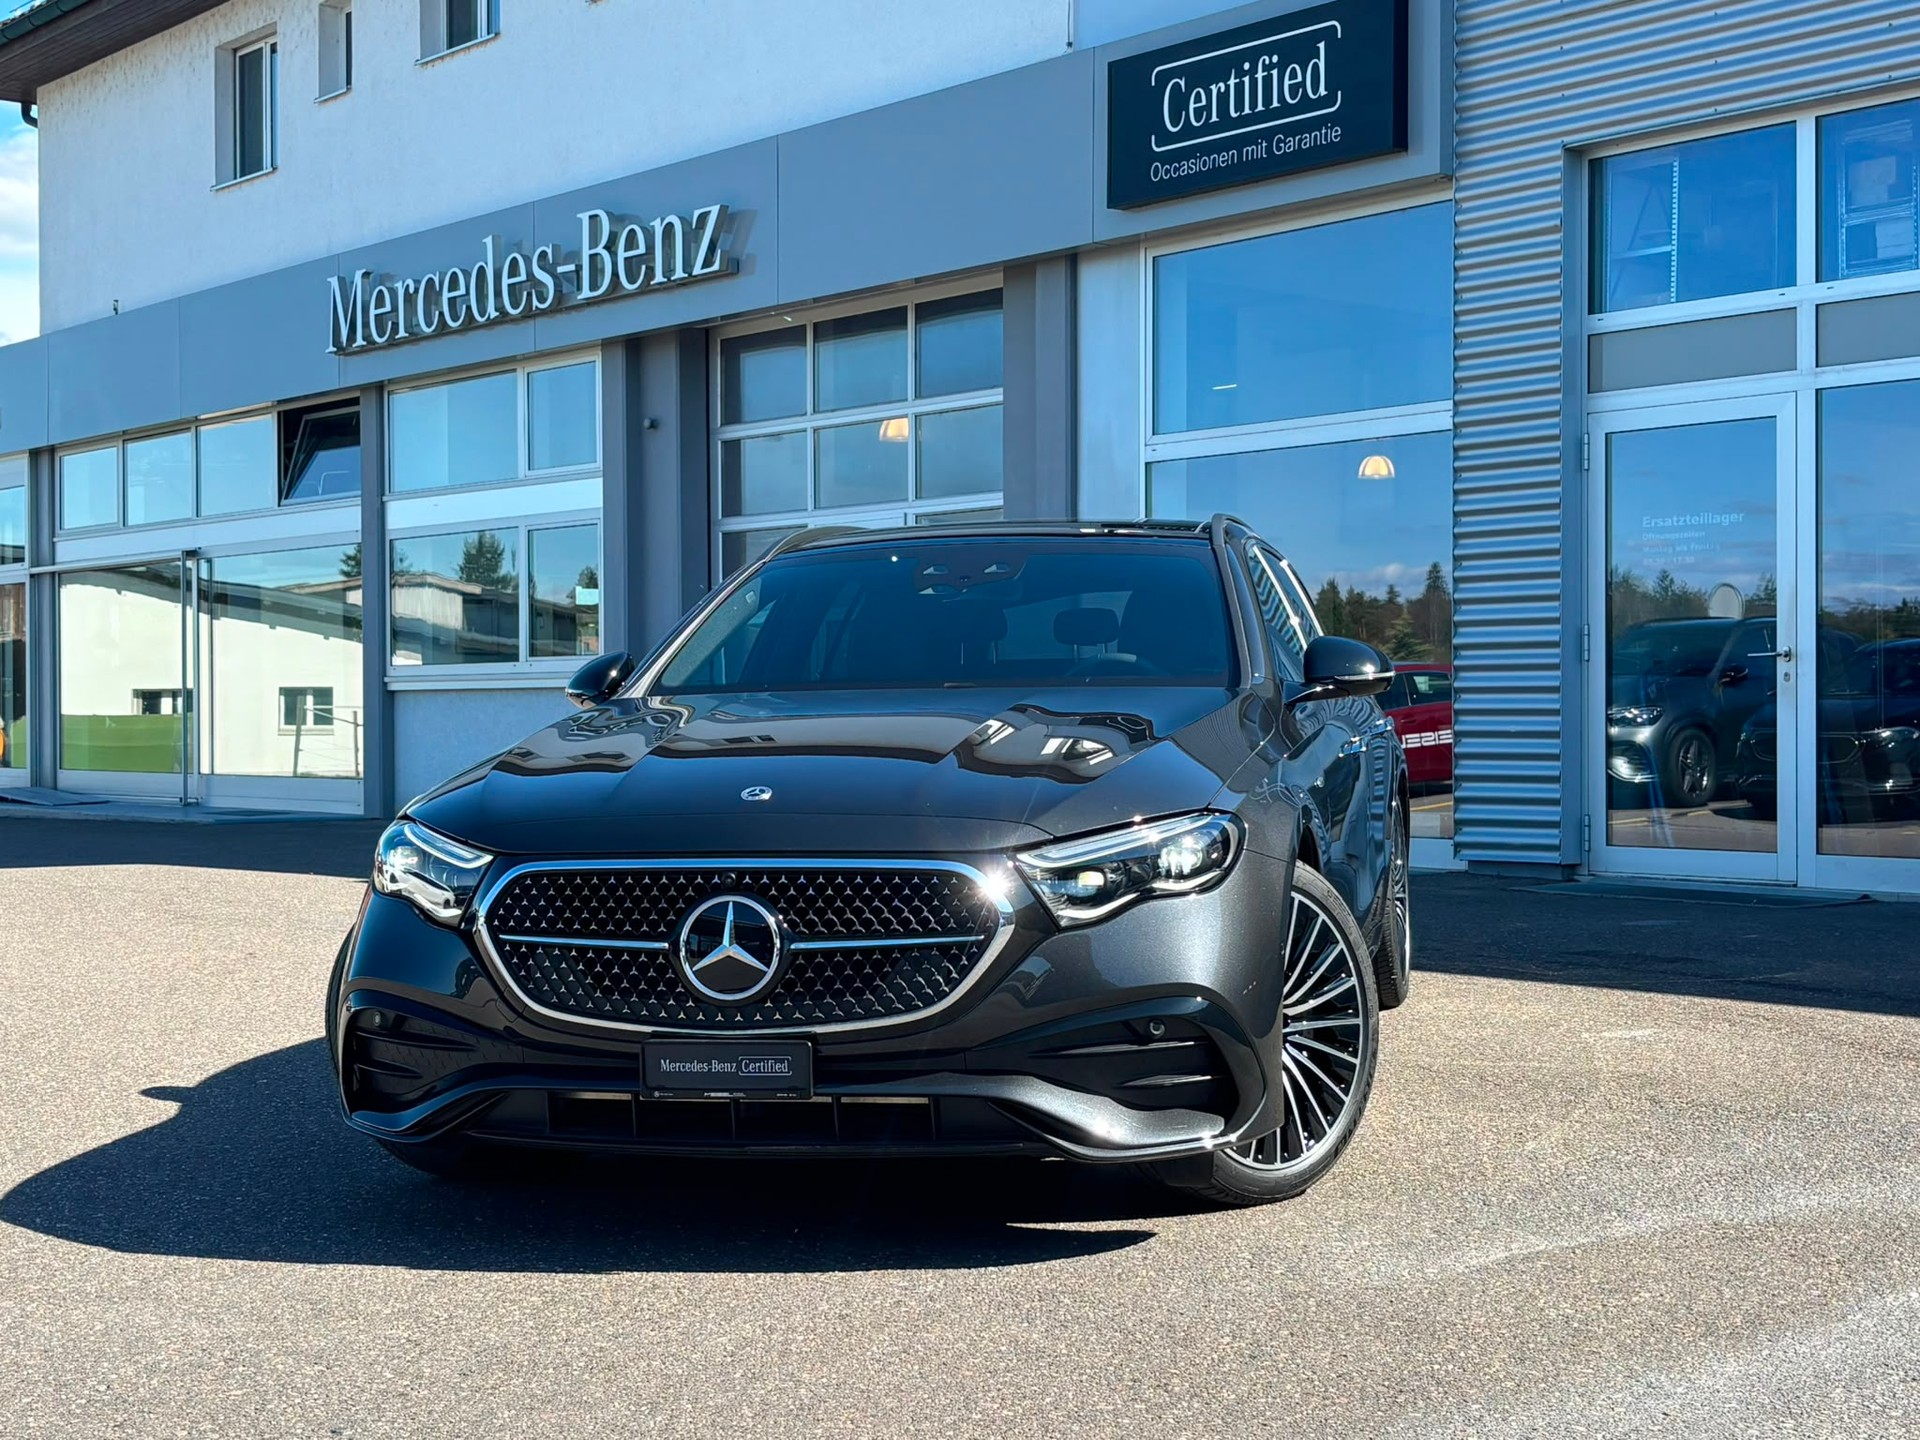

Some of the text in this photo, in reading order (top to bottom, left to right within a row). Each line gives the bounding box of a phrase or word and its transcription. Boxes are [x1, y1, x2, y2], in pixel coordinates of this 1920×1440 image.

[1163, 41, 1328, 133] Certified
[1150, 124, 1341, 182] Occasionen mit Garantie
[325, 203, 730, 354] Mercedes-Benz
[1642, 512, 1744, 528] Ersatzteillager
[660, 1058, 788, 1073] Mercedes-Benz Certified
